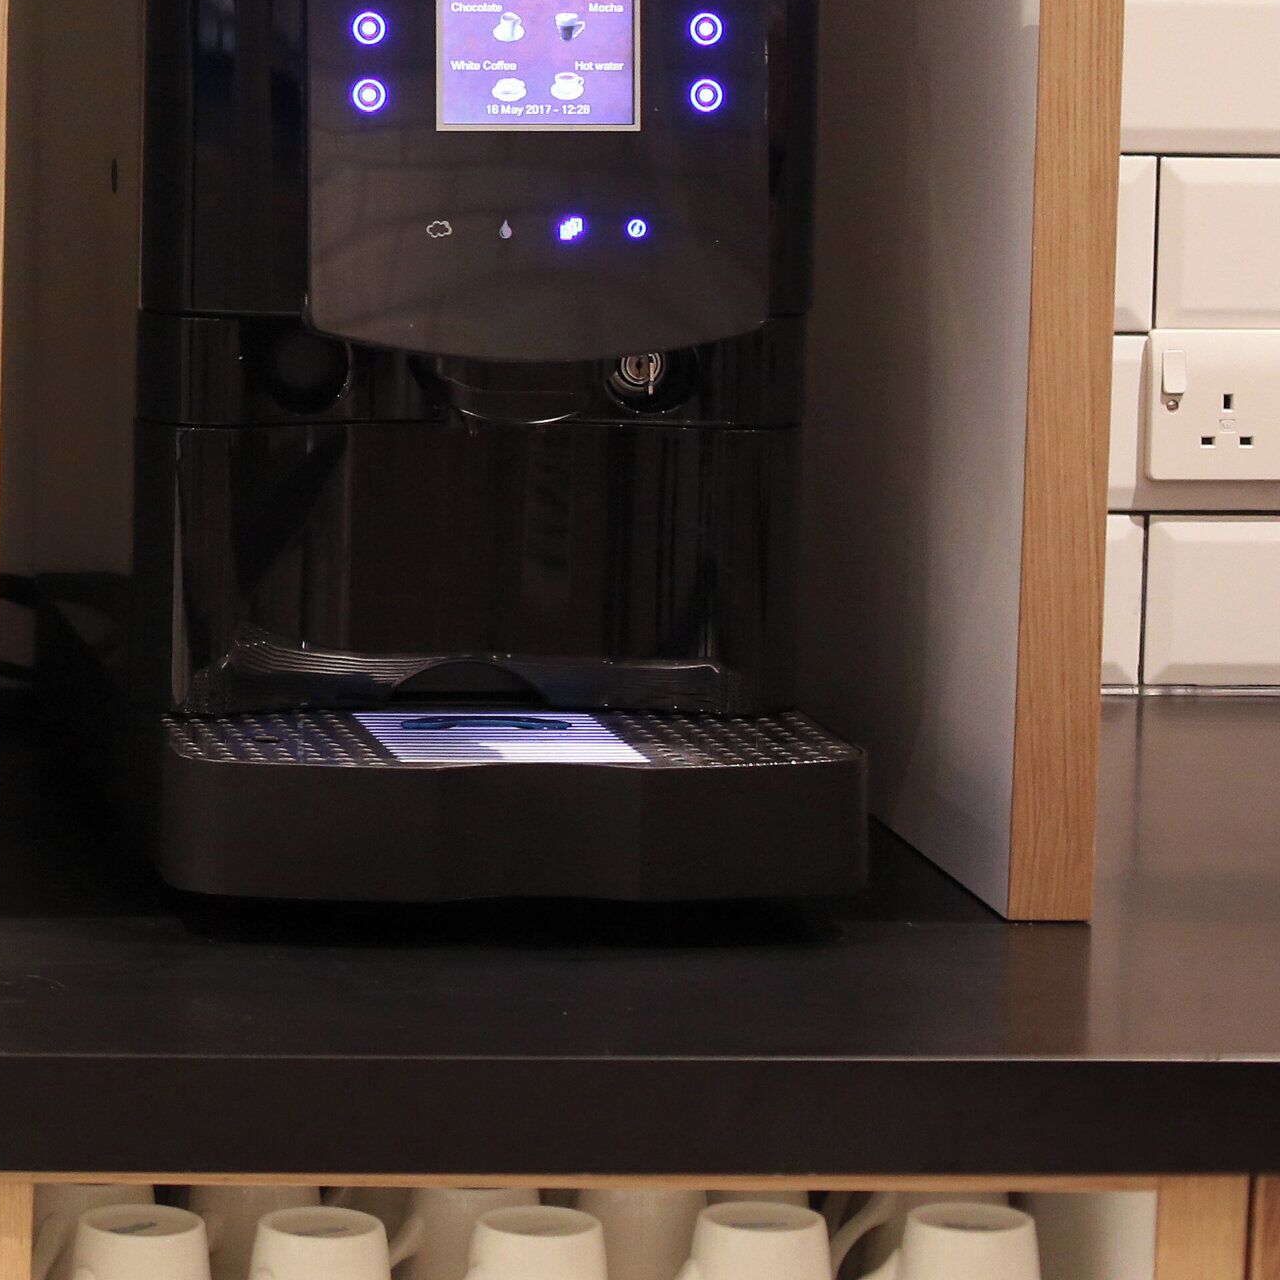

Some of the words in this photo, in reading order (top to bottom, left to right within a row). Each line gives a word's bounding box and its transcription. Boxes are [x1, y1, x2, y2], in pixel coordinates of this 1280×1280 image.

[450, 2, 503, 13] Chocolate
[589, 2, 624, 13] Mocha
[450, 60, 481, 71] White
[482, 60, 517, 71] Coffee
[574, 60, 593, 71] Hot
[594, 61, 624, 71] water
[500, 104, 524, 117] May
[525, 104, 552, 115] 2017
